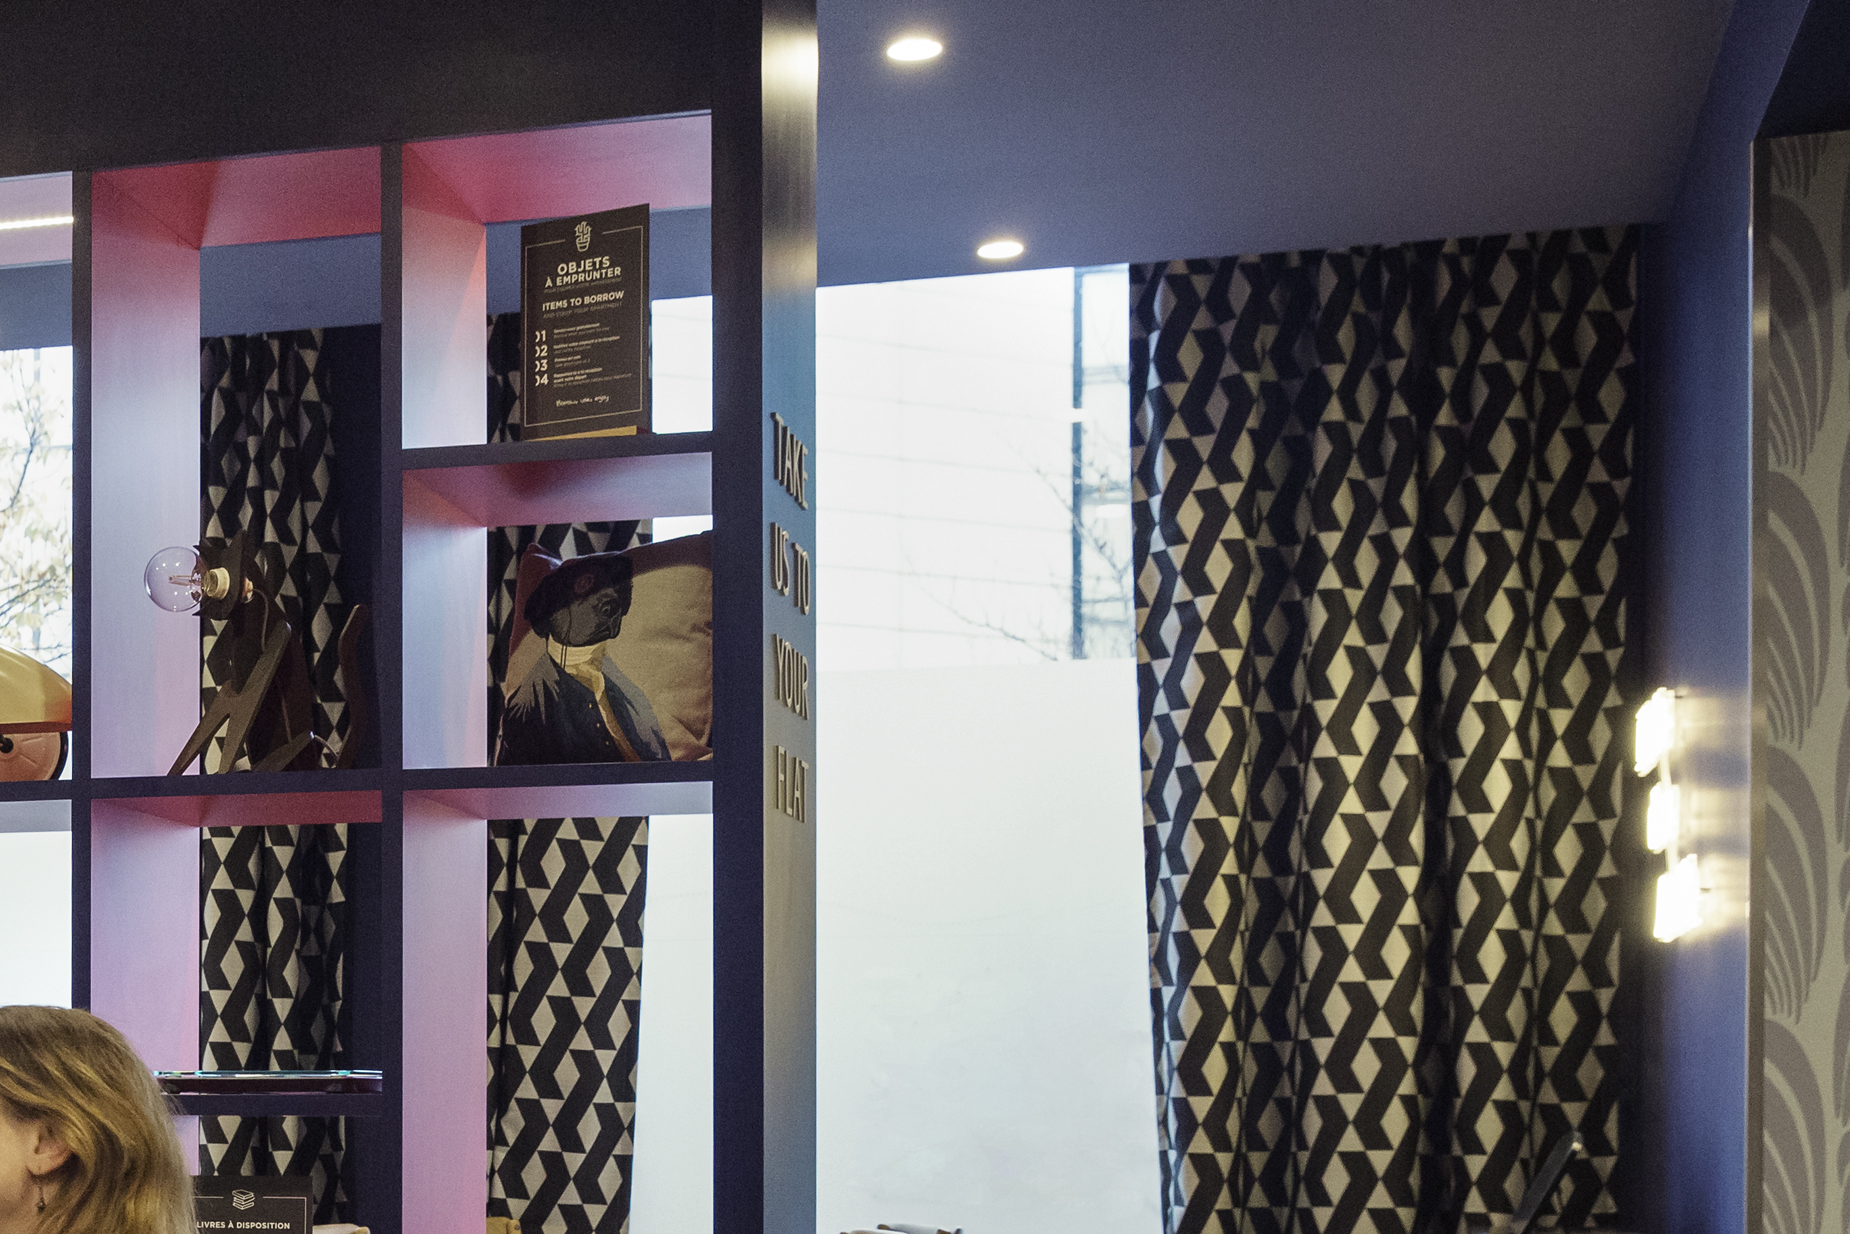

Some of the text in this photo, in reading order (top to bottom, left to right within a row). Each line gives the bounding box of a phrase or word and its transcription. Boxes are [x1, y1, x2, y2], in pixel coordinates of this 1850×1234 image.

[545, 276, 553, 288] À
[556, 266, 622, 286] EMPRUNTER
[557, 256, 610, 275] OBJETS
[542, 290, 625, 312] ITEMS TO BORROW
[770, 411, 809, 511] TAKE
[769, 521, 810, 615] US TO
[771, 633, 810, 721] YOUR
[773, 744, 810, 824] FLAT
[196, 1219, 291, 1230] LIVRES À DISPOSITION
